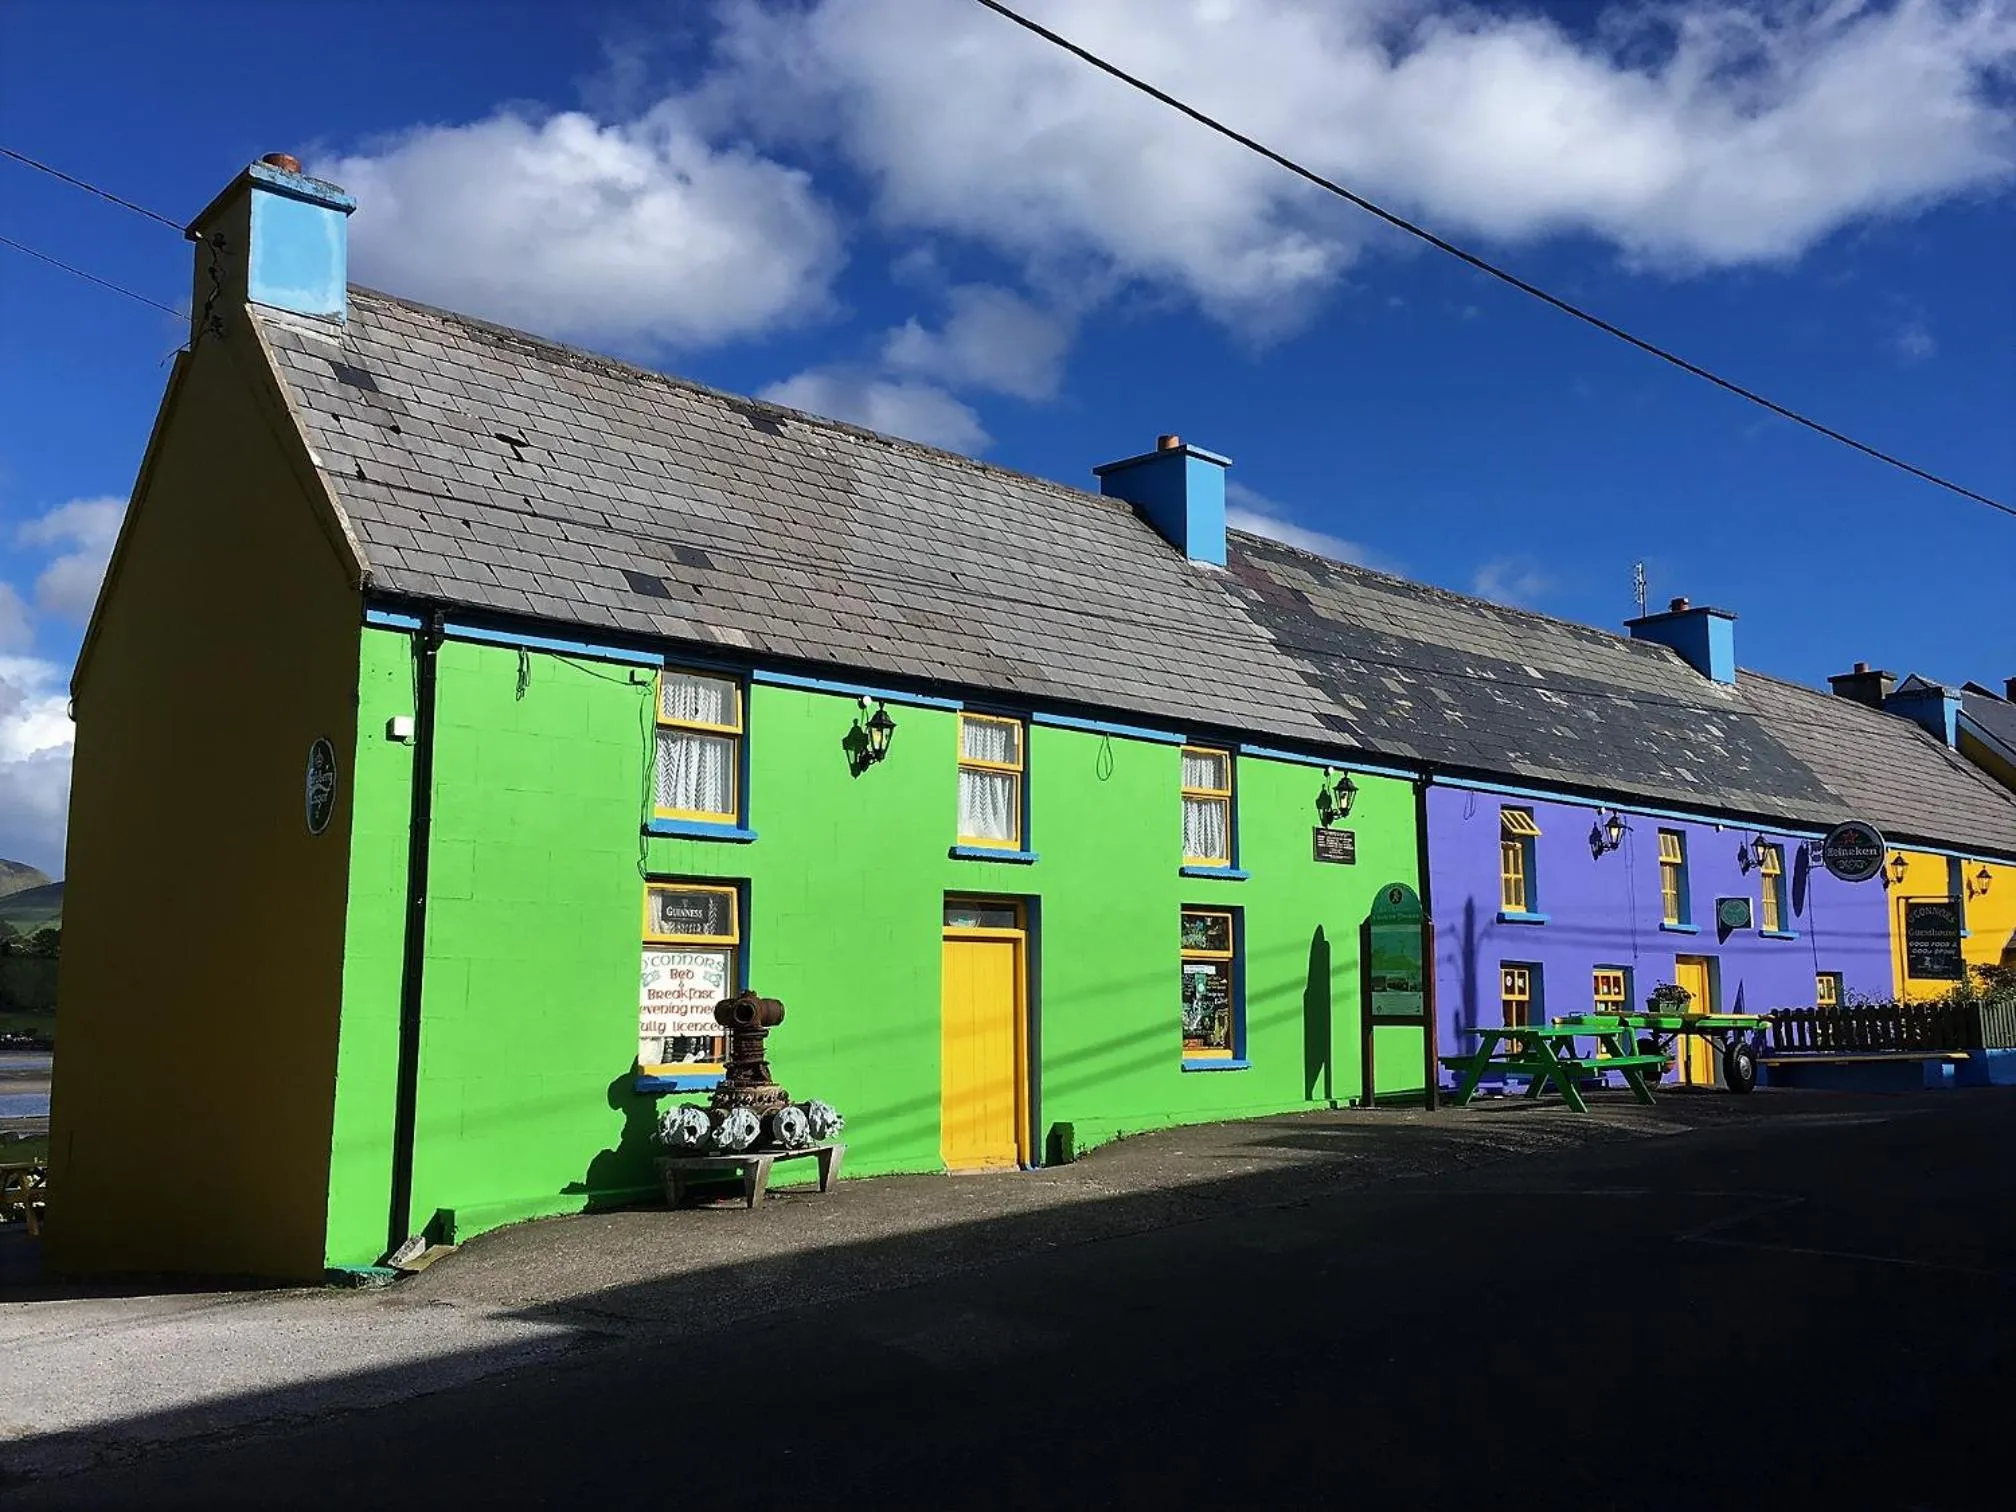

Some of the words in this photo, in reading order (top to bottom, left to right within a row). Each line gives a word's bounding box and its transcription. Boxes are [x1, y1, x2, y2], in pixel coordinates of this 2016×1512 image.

[1828, 846, 1878, 857] Heineken
[666, 906, 703, 918] GUINNESS
[647, 988, 716, 1001] Breakfast
[640, 1002, 689, 1016] evening
[640, 1020, 666, 1035] ully
